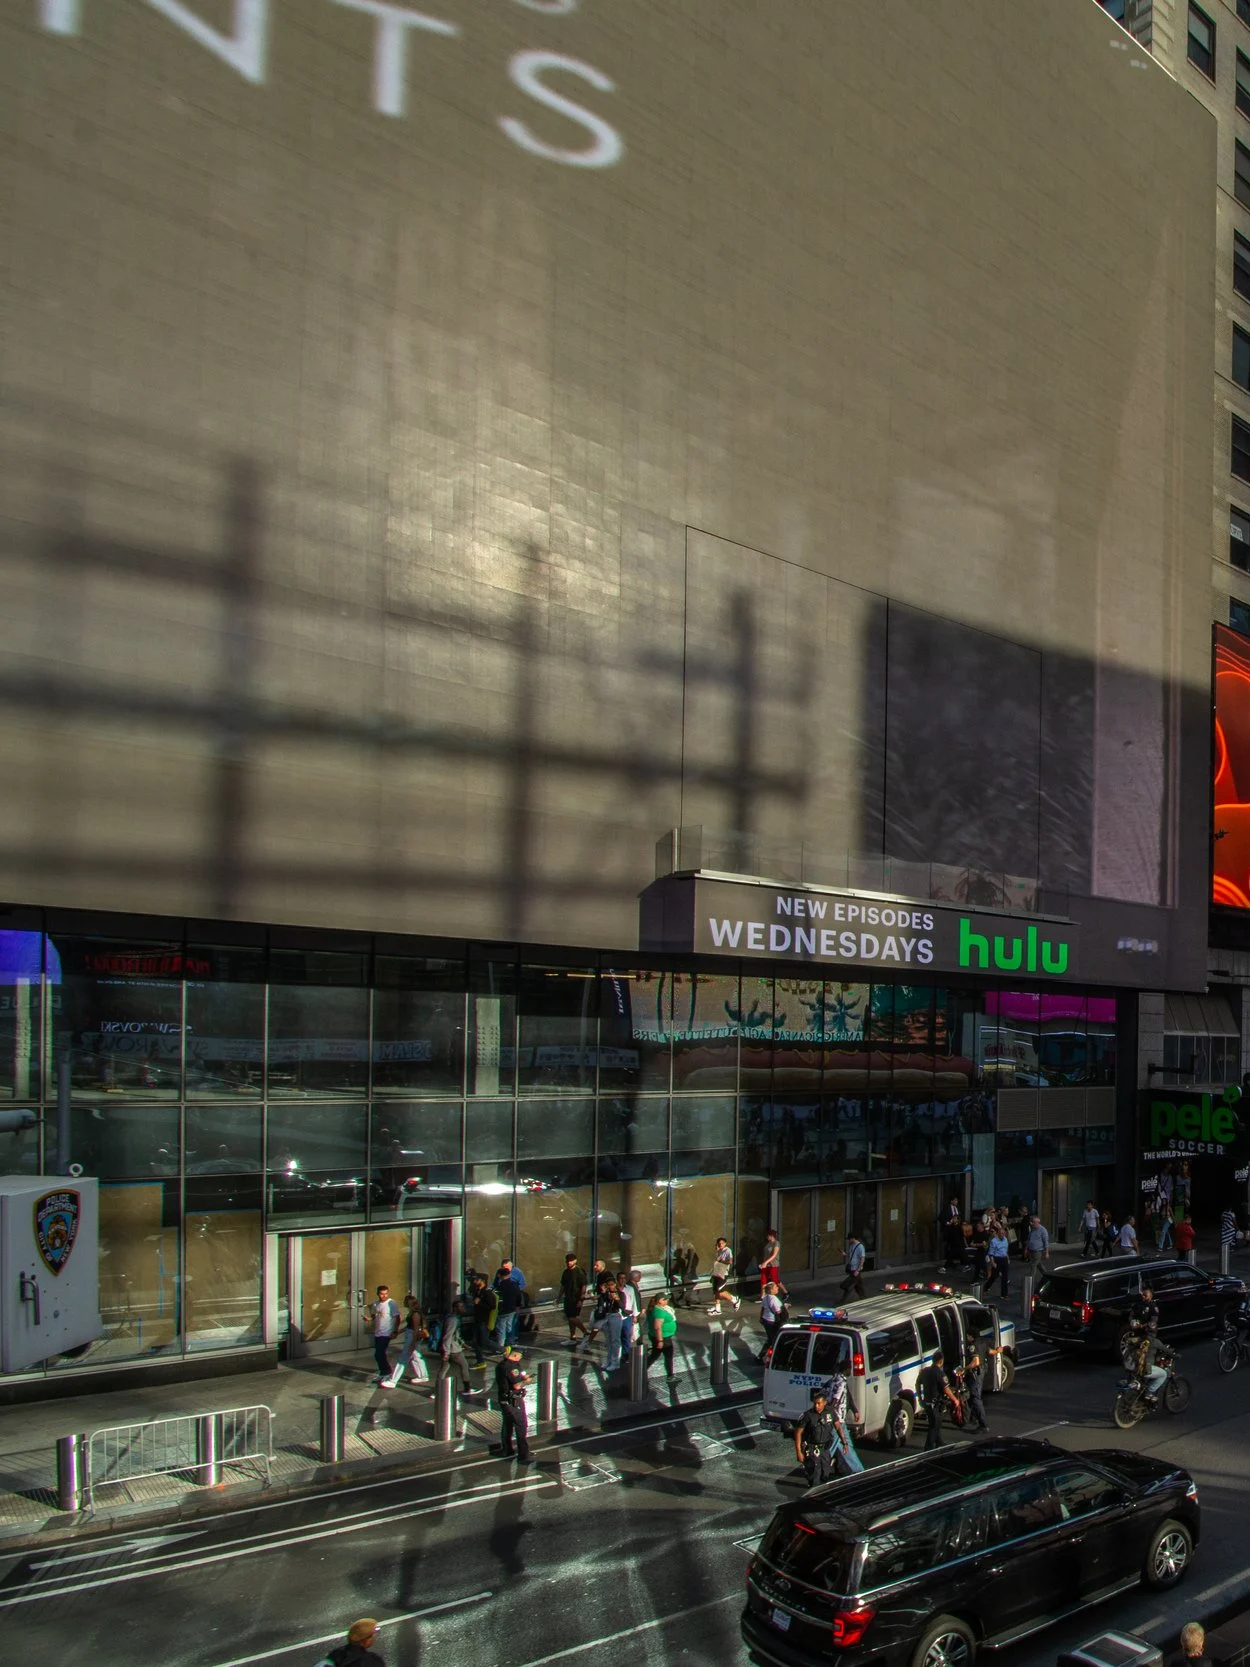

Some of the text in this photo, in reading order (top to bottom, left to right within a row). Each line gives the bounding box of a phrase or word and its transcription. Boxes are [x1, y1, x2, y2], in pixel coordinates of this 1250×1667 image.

[776, 896, 935, 932] NEW EPISODES
[708, 917, 935, 965] WEDNESDAYS
[958, 917, 1069, 975] hulu
[1150, 1084, 1243, 1147] pelé
[1143, 1152, 1156, 1161] THE
[1168, 1138, 1225, 1156] SOCCER
[46, 1194, 70, 1206] POLICE
[38, 1203, 77, 1222] DEPARTMENT
[793, 1374, 822, 1382] NYPD
